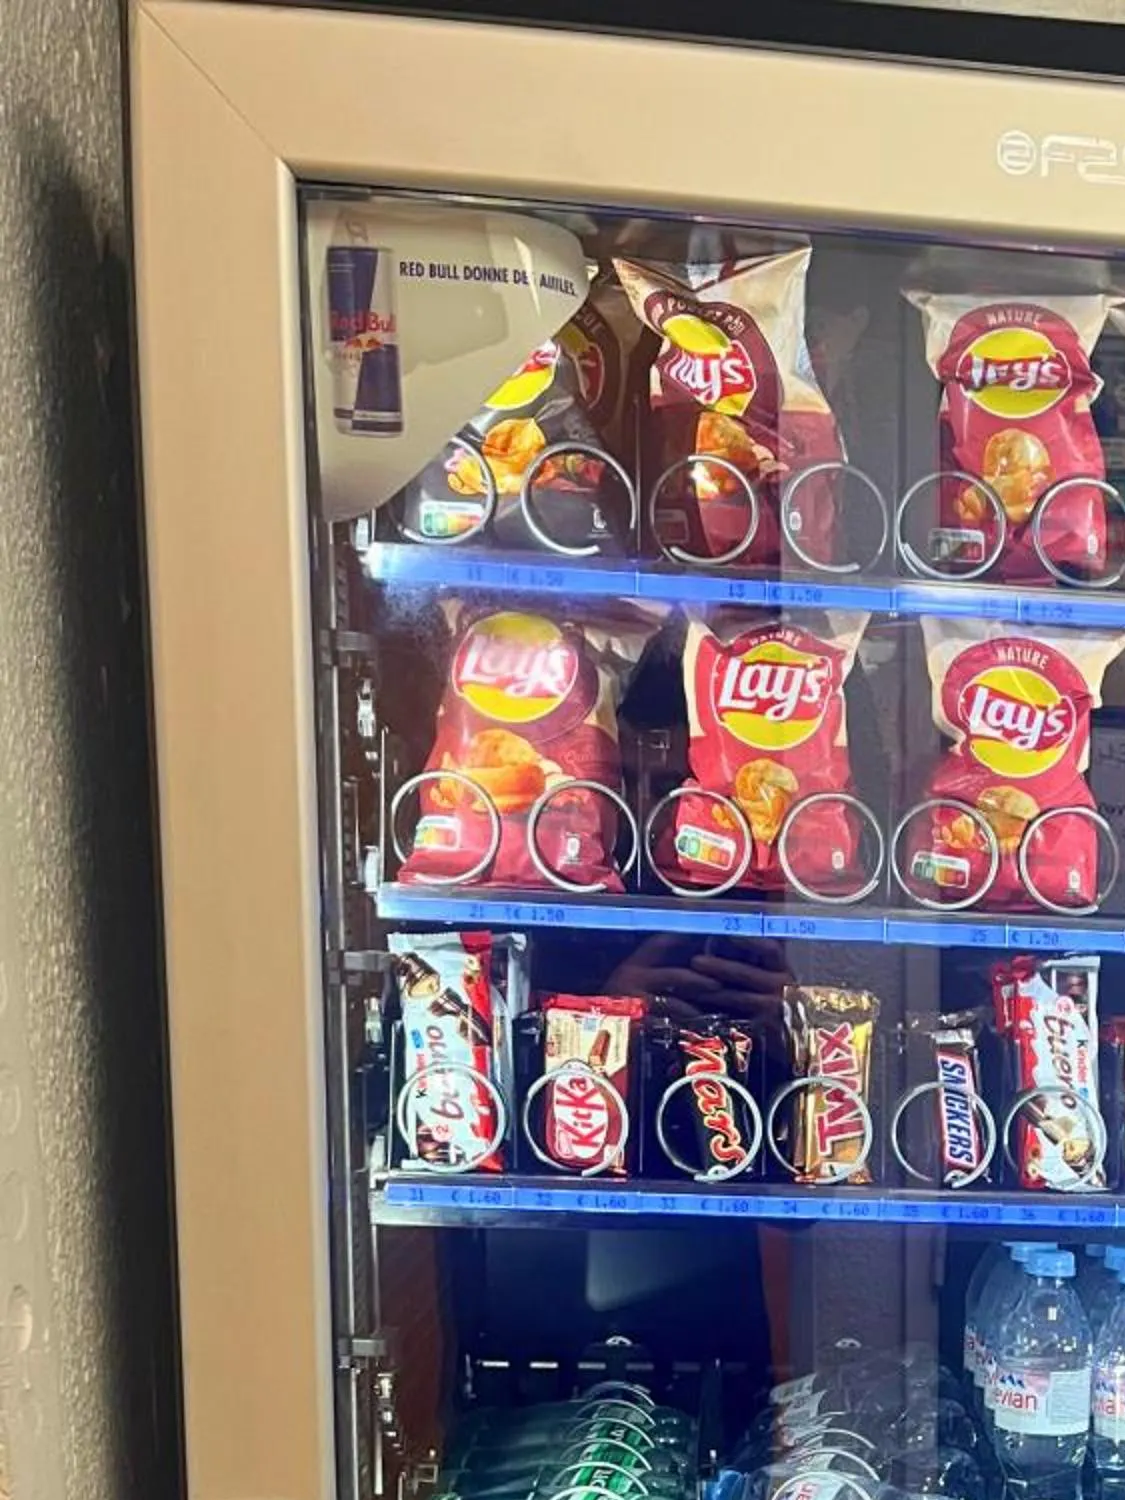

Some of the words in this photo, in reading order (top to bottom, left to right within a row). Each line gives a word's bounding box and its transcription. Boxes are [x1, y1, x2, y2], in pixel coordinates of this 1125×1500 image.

[399, 260, 425, 278] RED
[428, 263, 460, 281] BULL
[462, 266, 509, 284] DONNE
[986, 311, 1044, 327] NATURE
[716, 656, 829, 718] Lay's
[995, 646, 1049, 668] NATURE
[967, 685, 1069, 749] Lay's
[555, 1064, 605, 1148] KitKa
[678, 1029, 748, 1165] Mars
[816, 1022, 866, 1156] TWIX
[939, 1060, 975, 1164] SNICKERS
